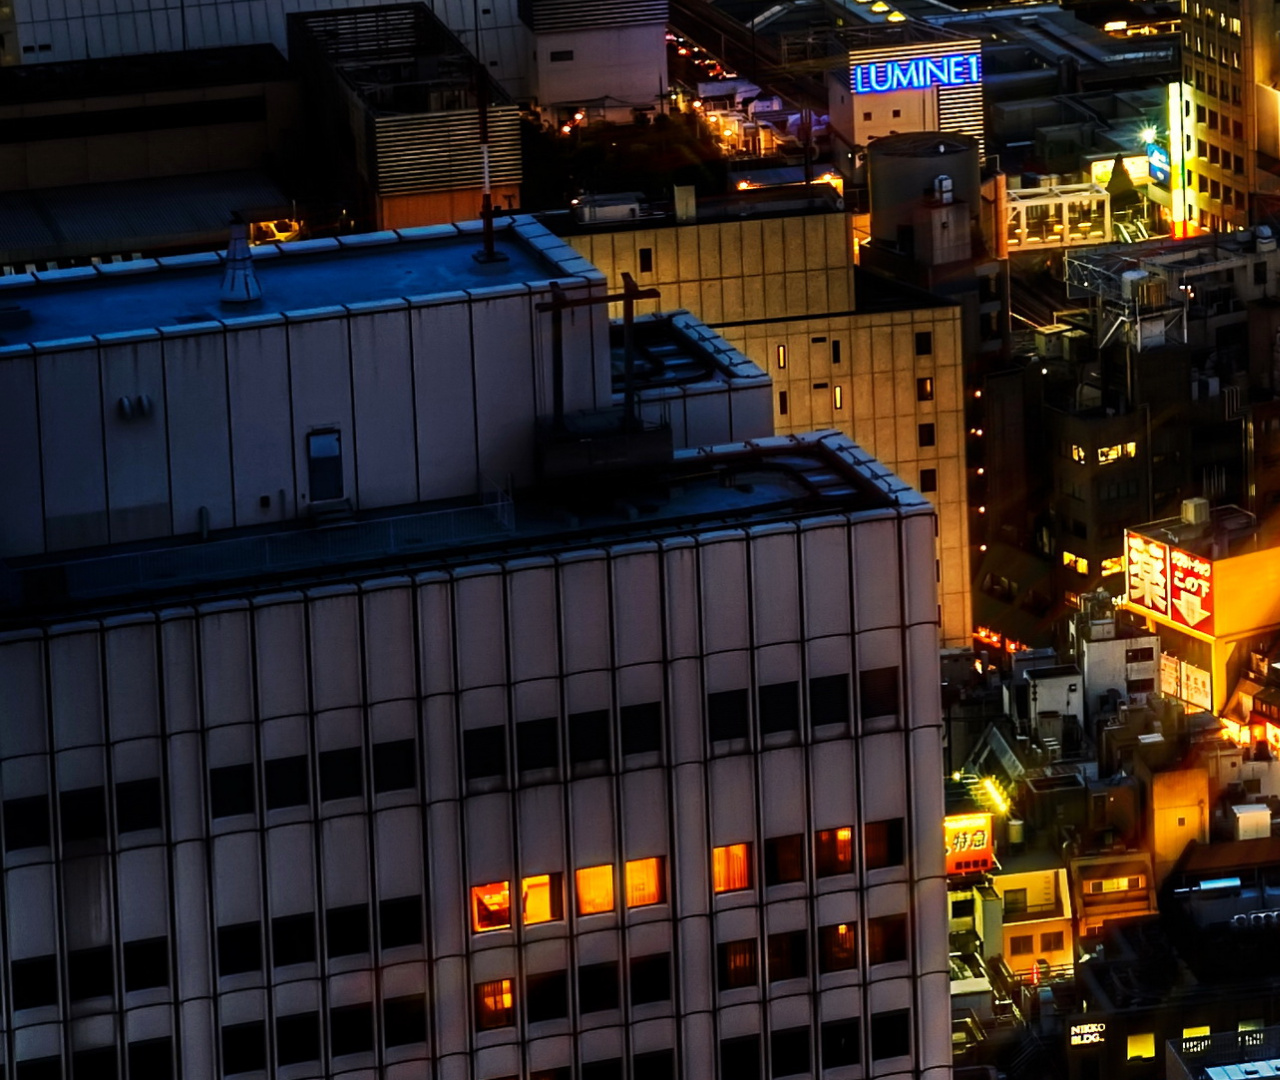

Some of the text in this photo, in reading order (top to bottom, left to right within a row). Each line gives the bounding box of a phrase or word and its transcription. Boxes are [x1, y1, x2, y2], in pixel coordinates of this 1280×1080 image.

[1129, 547, 1168, 612] 薬
[1173, 570, 1211, 598] この下
